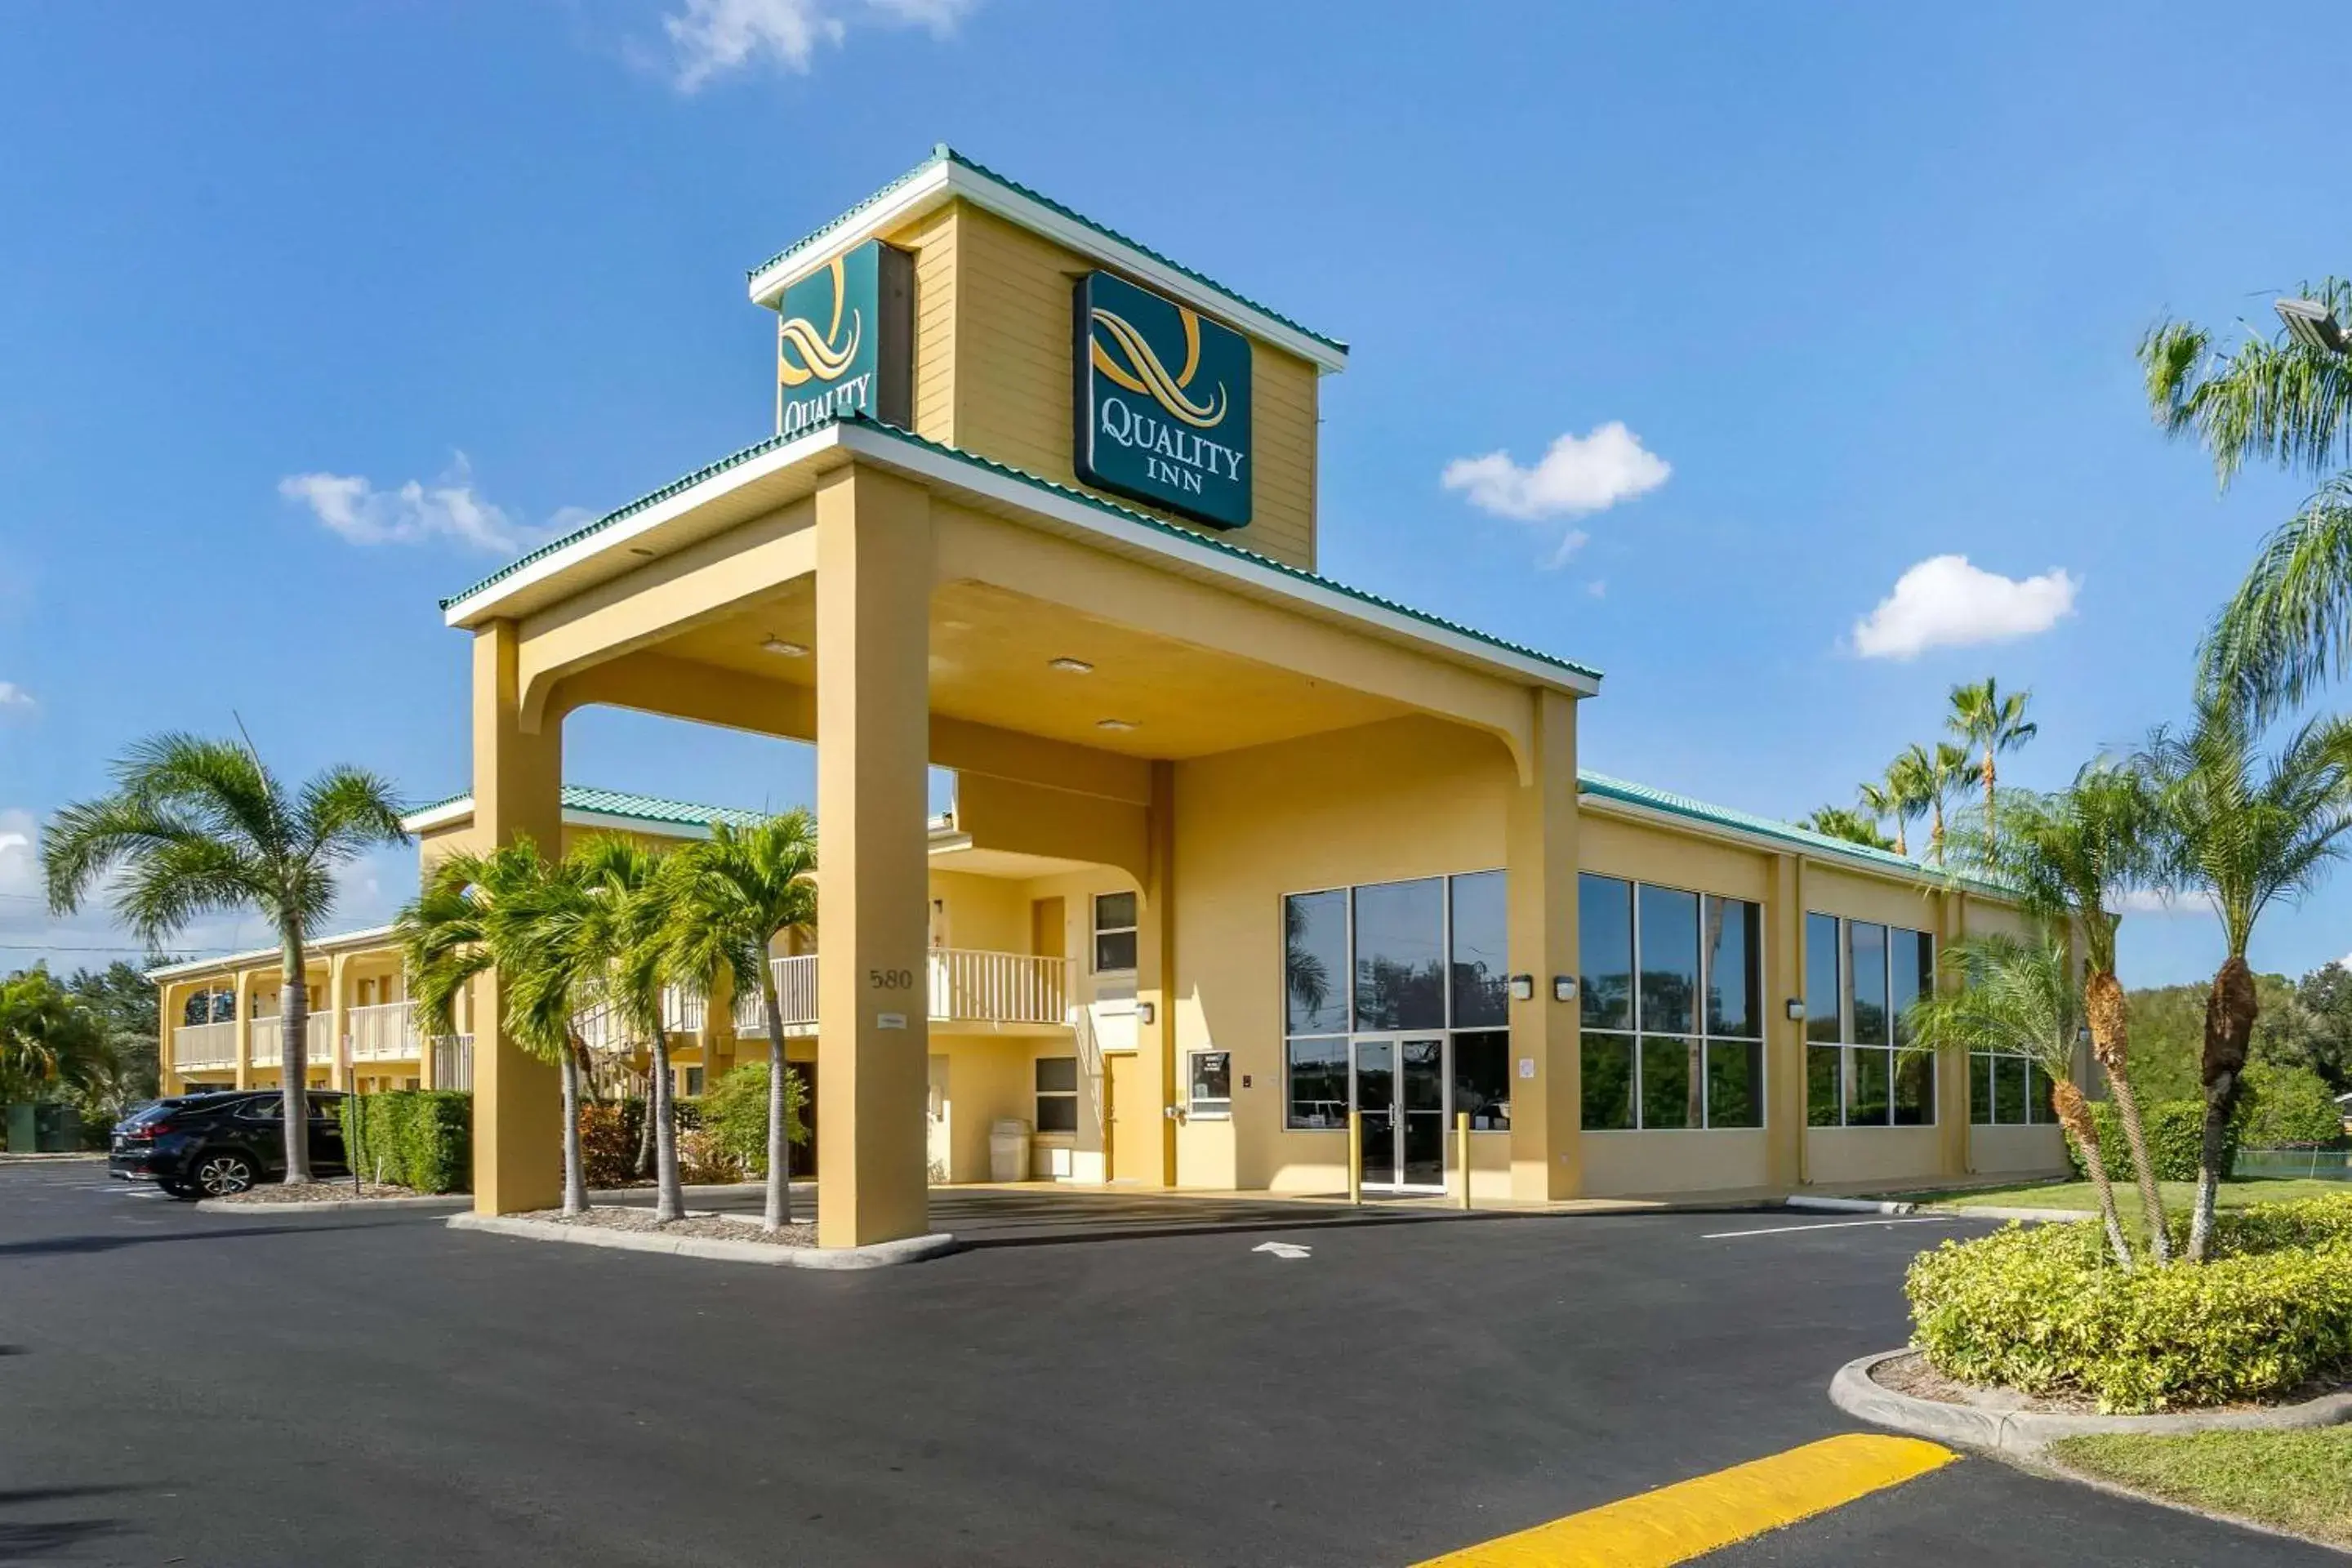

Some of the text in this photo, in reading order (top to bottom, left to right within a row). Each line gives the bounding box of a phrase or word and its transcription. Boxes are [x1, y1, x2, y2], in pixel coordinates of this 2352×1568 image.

[1102, 397, 1244, 482] QUALITY
[1147, 457, 1202, 495] INN
[870, 969, 913, 990] 580
